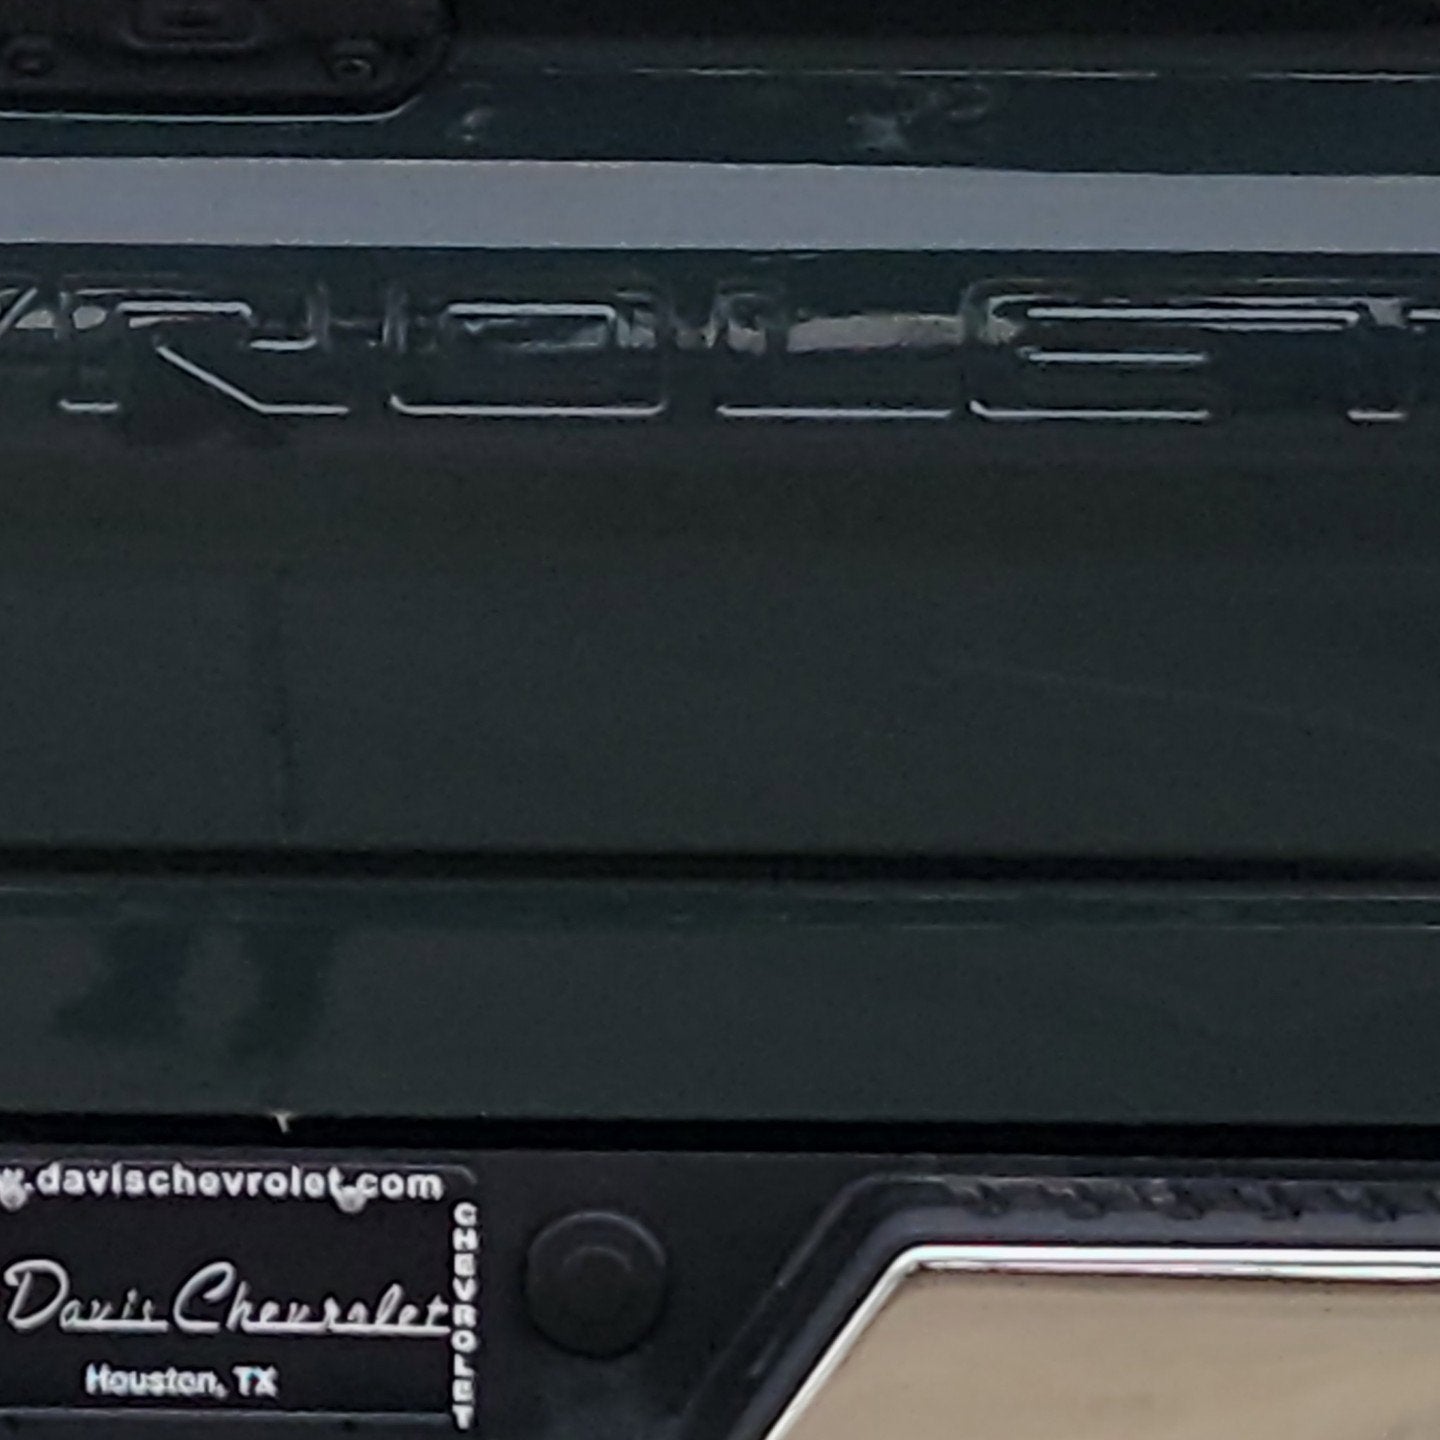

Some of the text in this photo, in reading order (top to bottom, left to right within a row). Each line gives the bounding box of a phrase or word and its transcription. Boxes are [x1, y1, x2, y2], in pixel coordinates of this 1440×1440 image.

[4, 1258, 169, 1332] Davis
[172, 1261, 451, 1336] Chevrolet
[452, 1202, 479, 1430] CHEVROLET
[84, 1363, 279, 1399] Houston, TX
